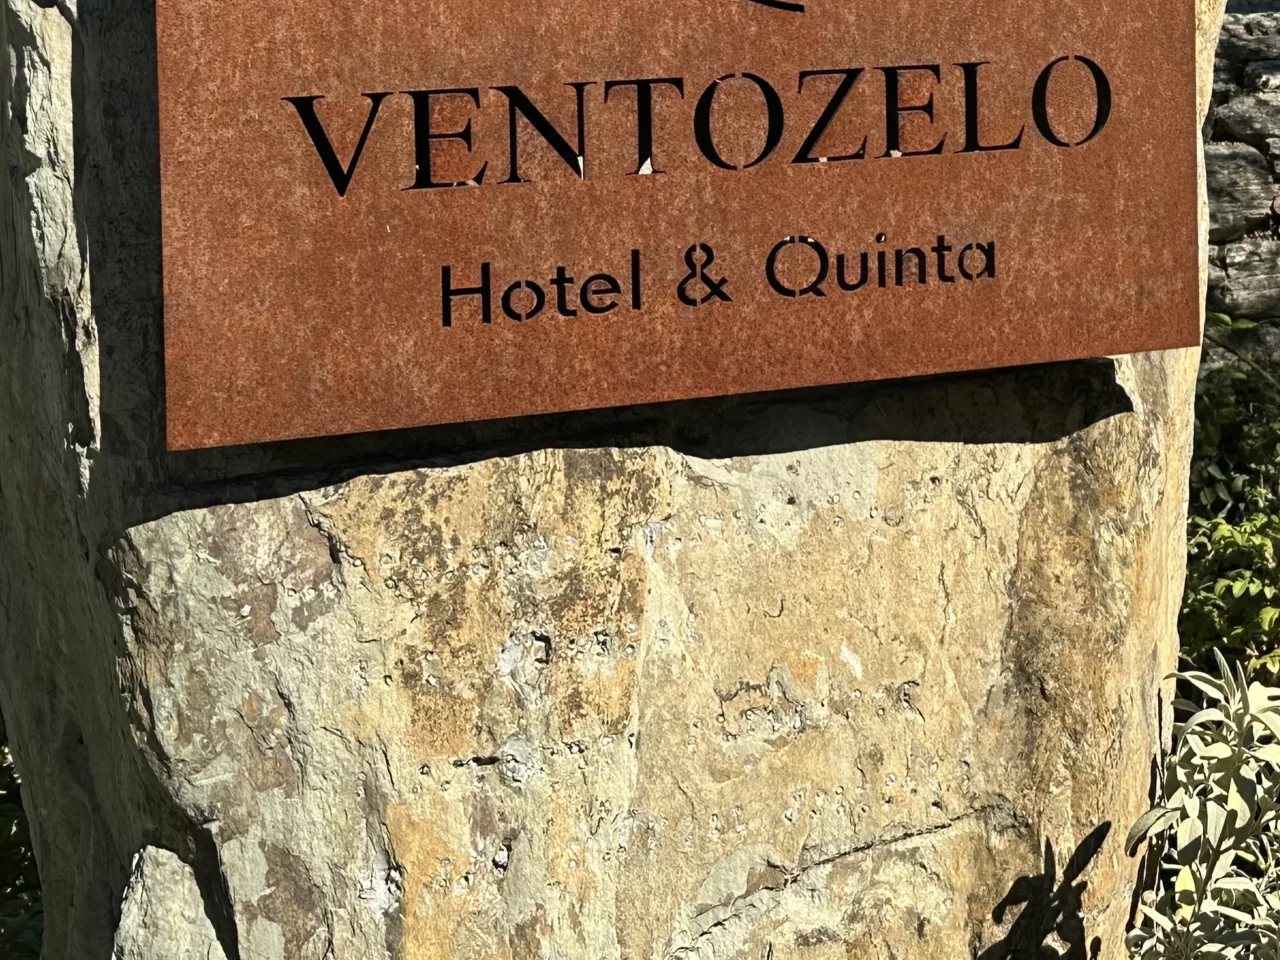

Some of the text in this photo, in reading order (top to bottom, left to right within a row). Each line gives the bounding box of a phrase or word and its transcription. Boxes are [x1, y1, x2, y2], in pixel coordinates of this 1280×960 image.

[282, 53, 1112, 197] VENTOZELO
[440, 232, 997, 328] Hotel & Quinta
